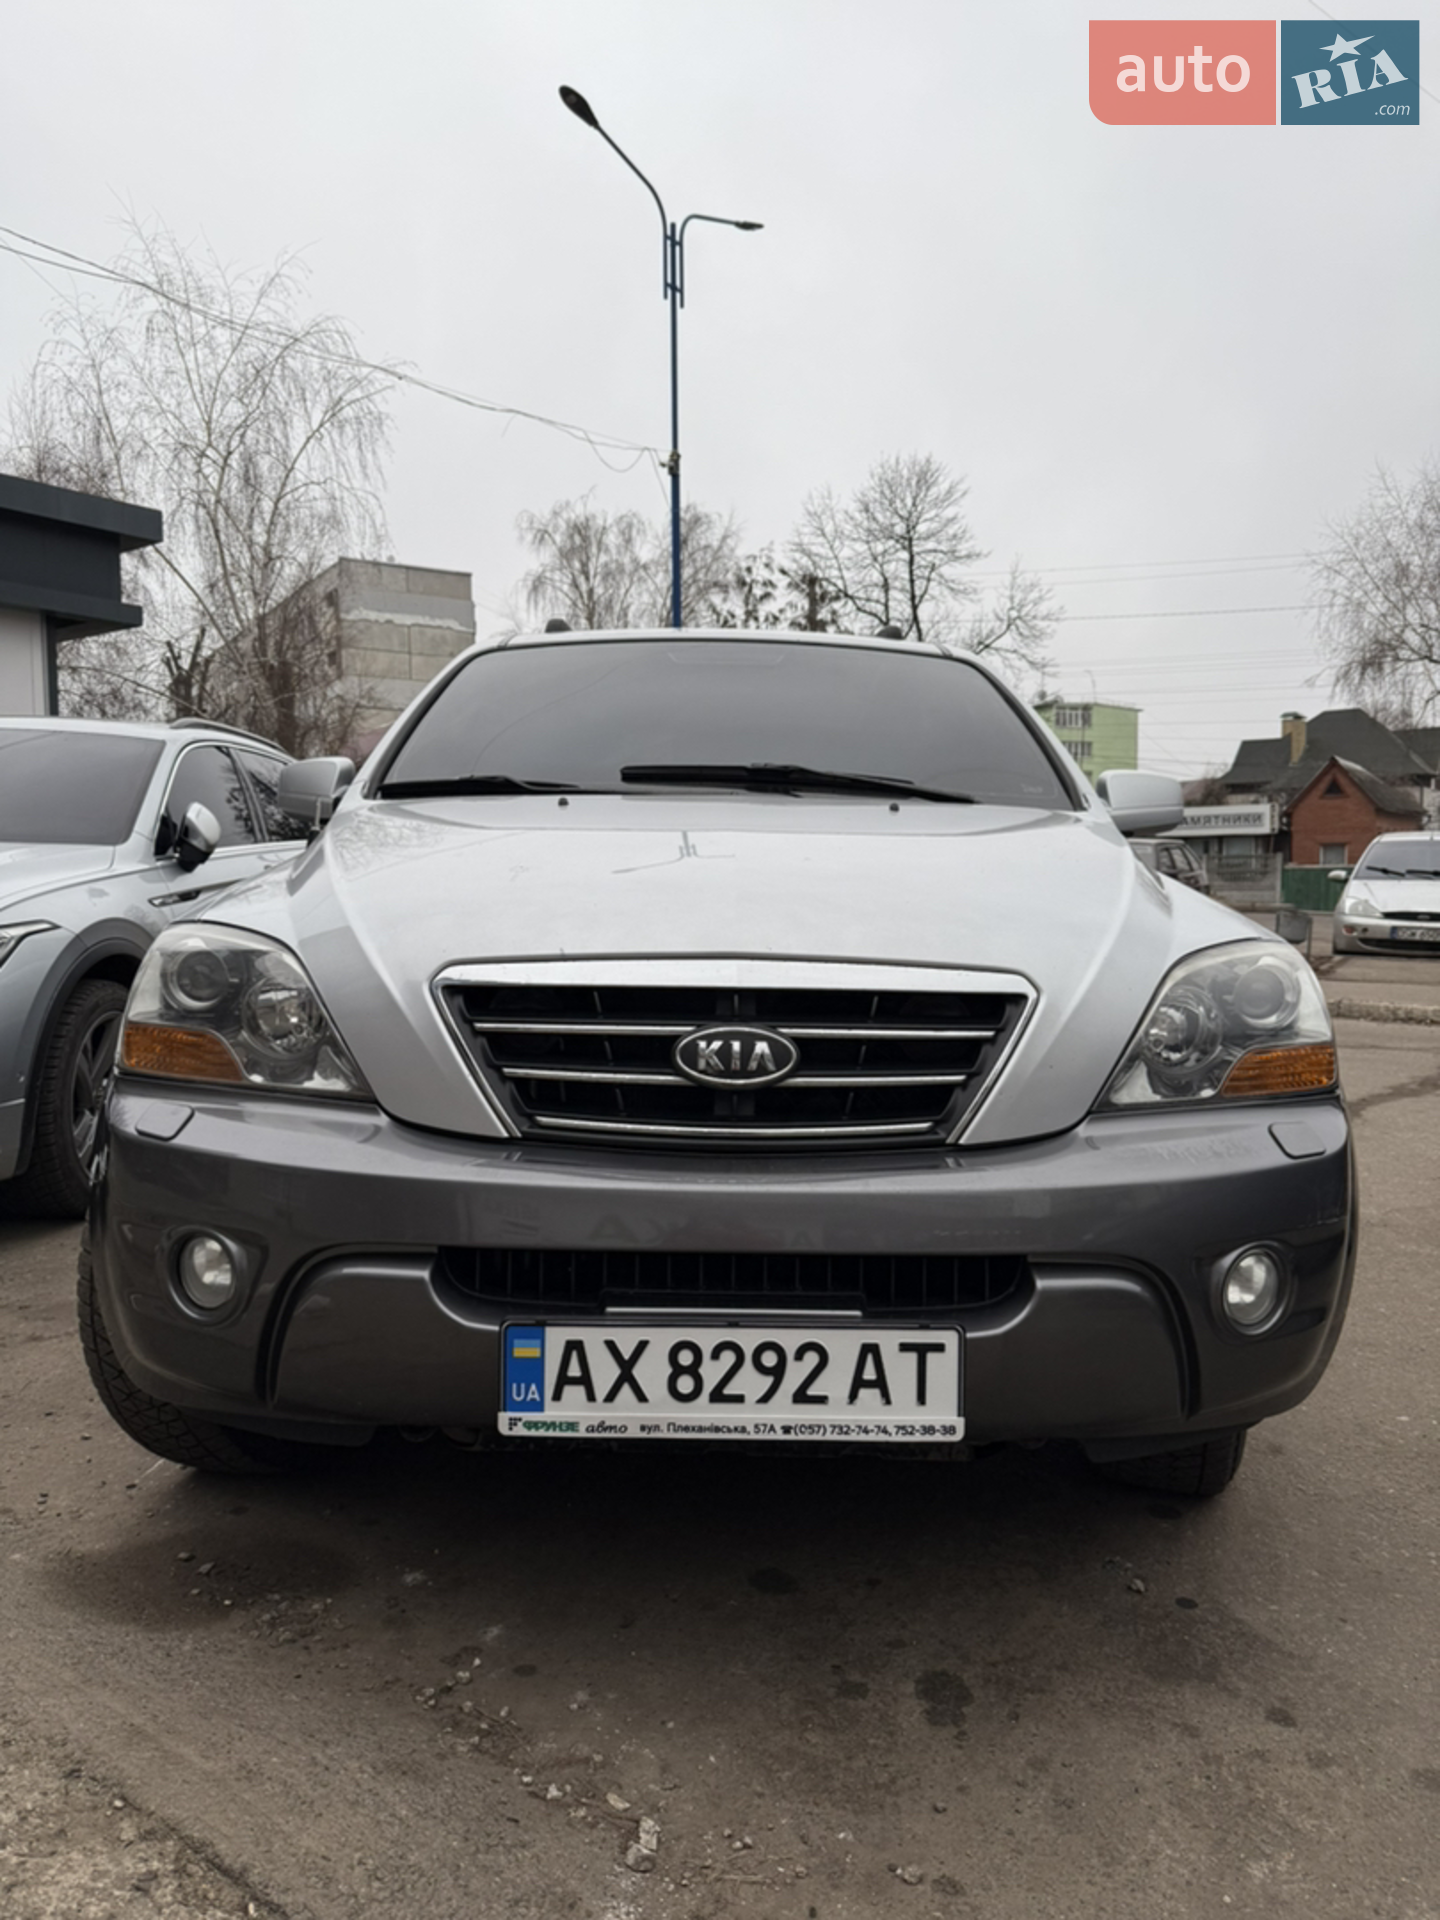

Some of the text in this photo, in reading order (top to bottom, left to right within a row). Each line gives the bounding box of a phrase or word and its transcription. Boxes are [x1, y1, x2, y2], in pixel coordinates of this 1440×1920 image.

[1180, 813, 1263, 827] АМЯТНИКИ
[696, 1040, 776, 1071] KIA
[551, 1339, 946, 1406] AX 8292 AT
[511, 1383, 541, 1402] UA
[639, 1423, 664, 1435] вул.
[830, 1425, 892, 1438] 732-74-74,
[894, 1424, 957, 1437] 752-38-38
